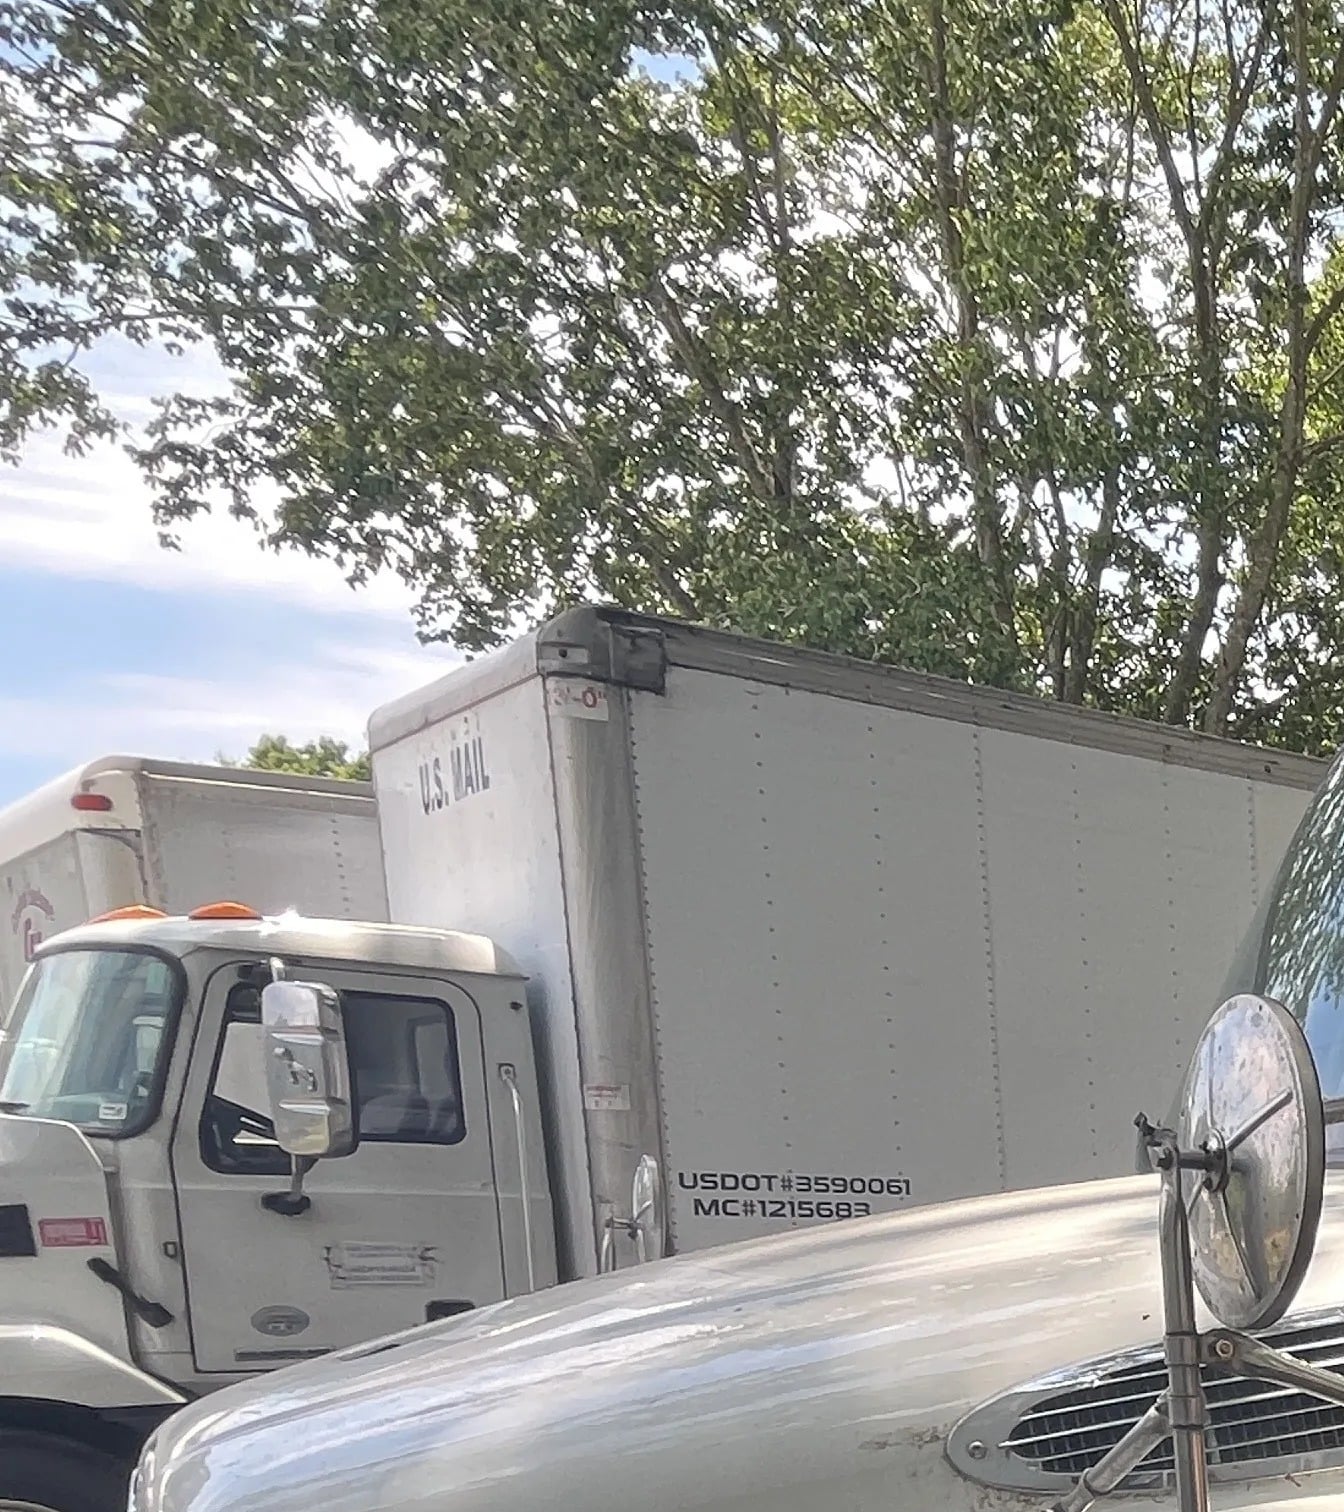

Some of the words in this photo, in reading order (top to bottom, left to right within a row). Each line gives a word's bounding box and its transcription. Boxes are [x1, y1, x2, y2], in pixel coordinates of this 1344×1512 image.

[419, 756, 450, 816] U.S.
[451, 736, 491, 802] MAIL
[678, 1172, 911, 1196] USDOT#3590061
[693, 1198, 872, 1219] MC#1215683
